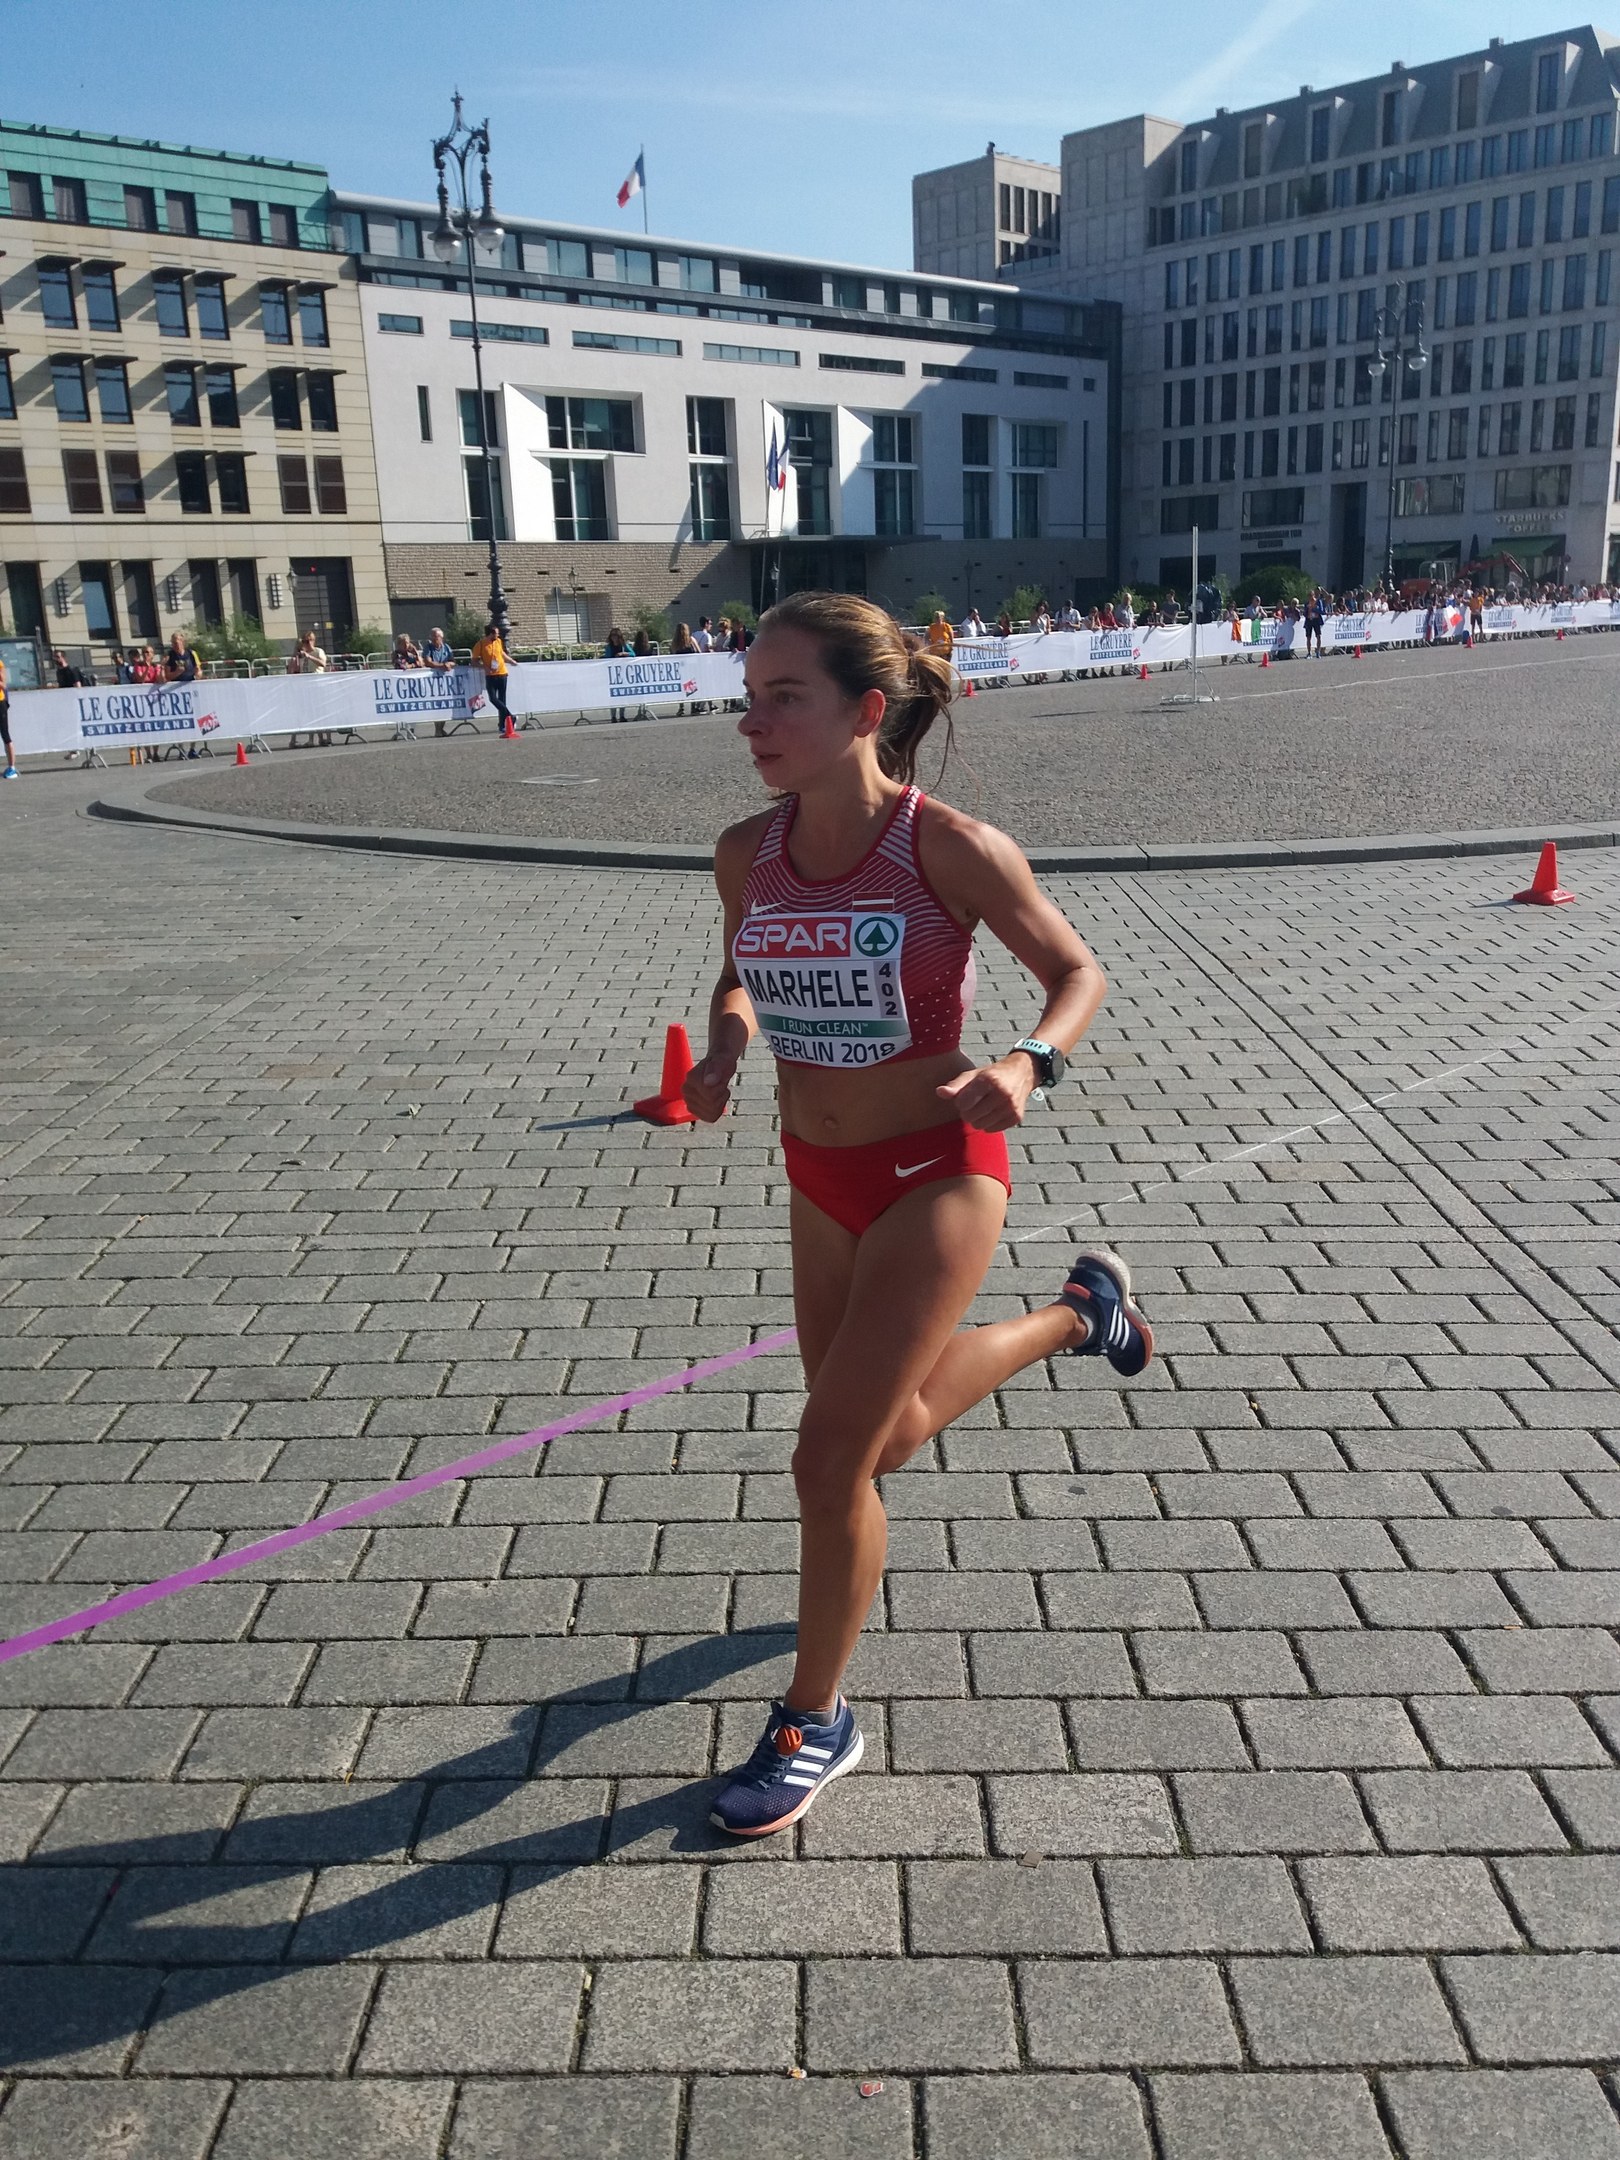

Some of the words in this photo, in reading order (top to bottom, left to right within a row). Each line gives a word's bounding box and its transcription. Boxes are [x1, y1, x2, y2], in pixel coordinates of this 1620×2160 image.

[1090, 635, 1099, 650] LE
[608, 665, 623, 685] LE
[373, 678, 393, 700] LE
[611, 684, 680, 696] SWITZERLAND
[78, 697, 102, 722] LE
[379, 699, 463, 713] SWITZERLAND
[86, 719, 193, 736] SWITZERLAND
[738, 922, 847, 953] SPAR
[743, 969, 873, 1008] MARHELE
[788, 1020, 813, 1034] RUN
[770, 1034, 834, 1063] BERLIN
[841, 1042, 896, 1064] 2018
